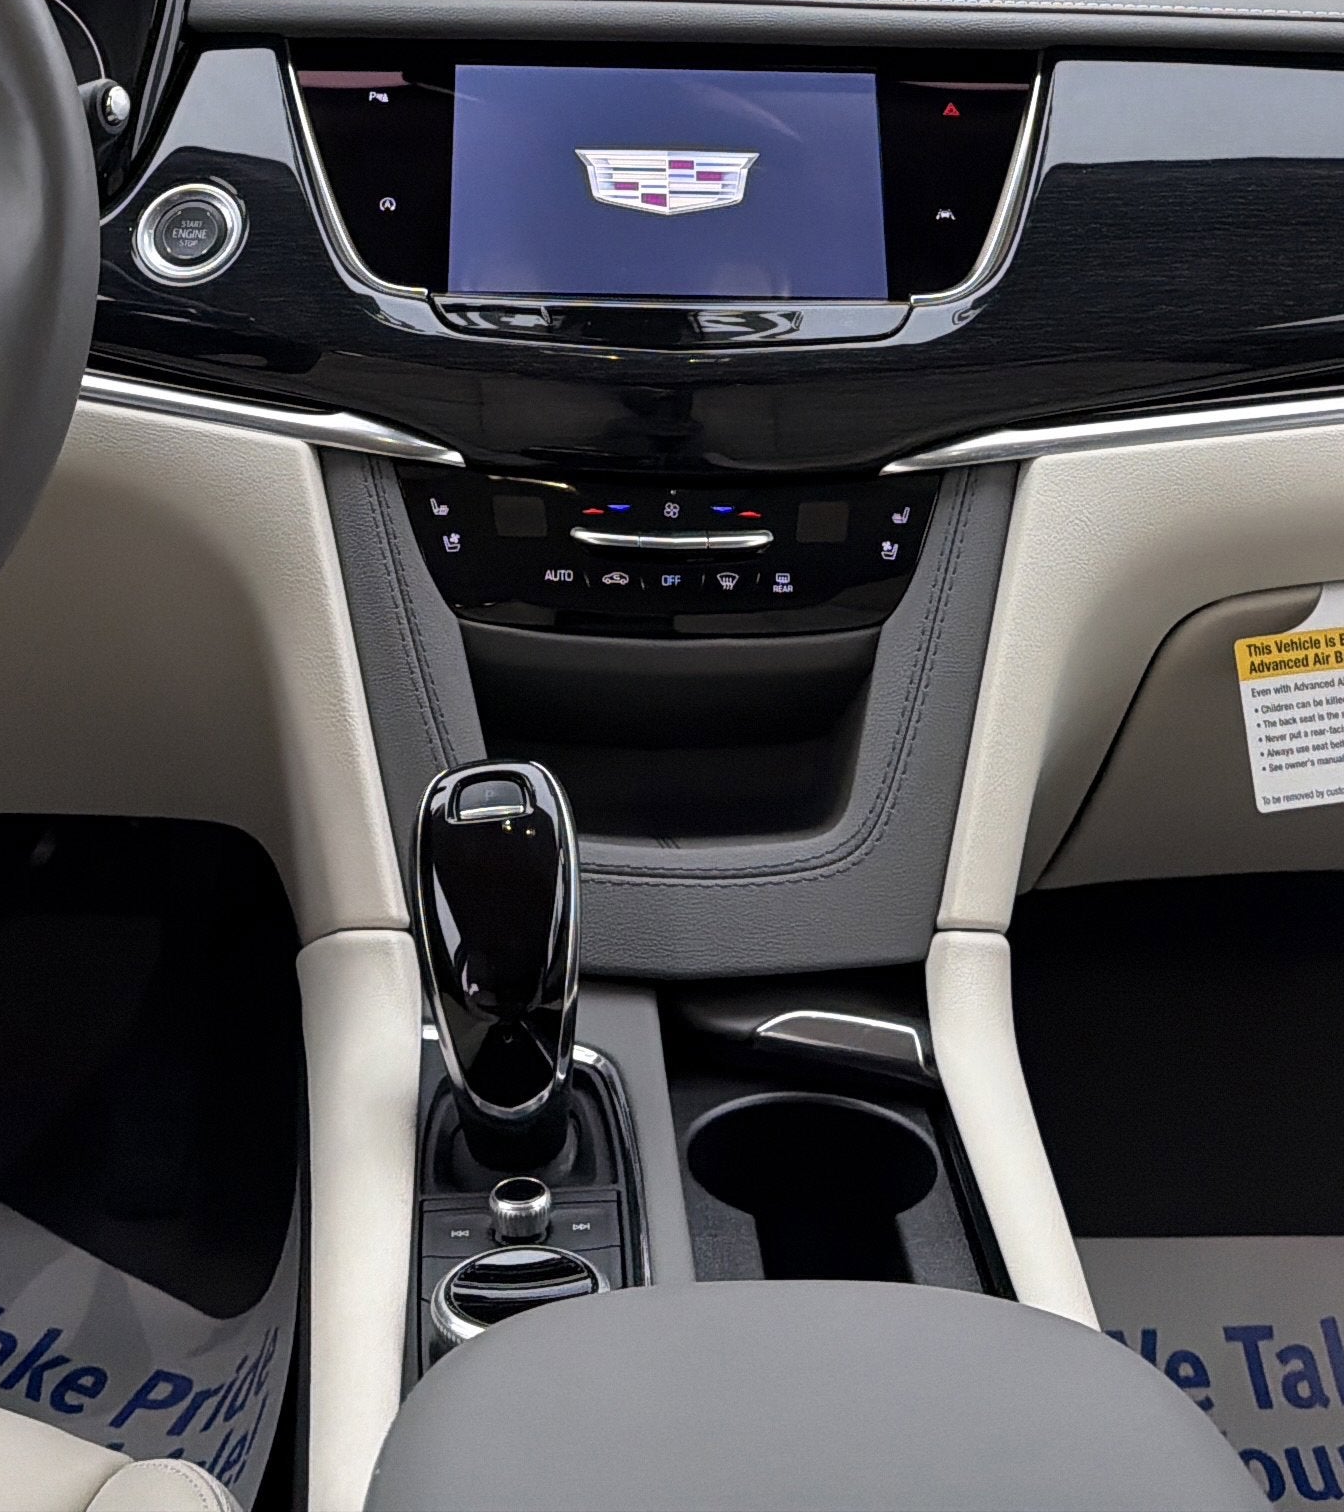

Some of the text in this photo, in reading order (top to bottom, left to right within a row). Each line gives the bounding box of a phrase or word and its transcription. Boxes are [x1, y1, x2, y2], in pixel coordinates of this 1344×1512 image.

[181, 220, 202, 228] START
[172, 229, 208, 239] ENGINE
[179, 239, 198, 247] STOP
[544, 570, 573, 582] AUTO
[661, 575, 681, 586] OFF
[773, 584, 793, 593] REAR
[1246, 642, 1272, 657] This
[1274, 636, 1320, 654] Vehicle
[1249, 654, 1309, 674] Advanced
[1313, 653, 1331, 668] Air
[1251, 688, 1271, 698] Even
[1273, 684, 1291, 694] with
[1294, 678, 1334, 692] Advanced
[1261, 703, 1294, 714] Children
[1296, 700, 1311, 709] can
[1313, 698, 1323, 706] be
[1263, 719, 1277, 728] The
[1279, 717, 1297, 727] back
[1299, 714, 1316, 723] seat
[1318, 713, 1324, 721] is
[1327, 711, 1339, 720] the
[1265, 733, 1286, 742] Never
[1289, 730, 1301, 741] put
[1267, 748, 1294, 759] Always
[1296, 746, 1309, 754] use
[1312, 742, 1328, 751] seat
[1269, 764, 1283, 772] See
[1285, 759, 1315, 770] owner's
[1317, 754, 1344, 765] manual
[1262, 796, 1270, 805] To
[1272, 795, 1281, 803] be
[1283, 791, 1314, 801] removed
[1316, 790, 1324, 798] by
[109, 1327, 278, 1436] Pride
